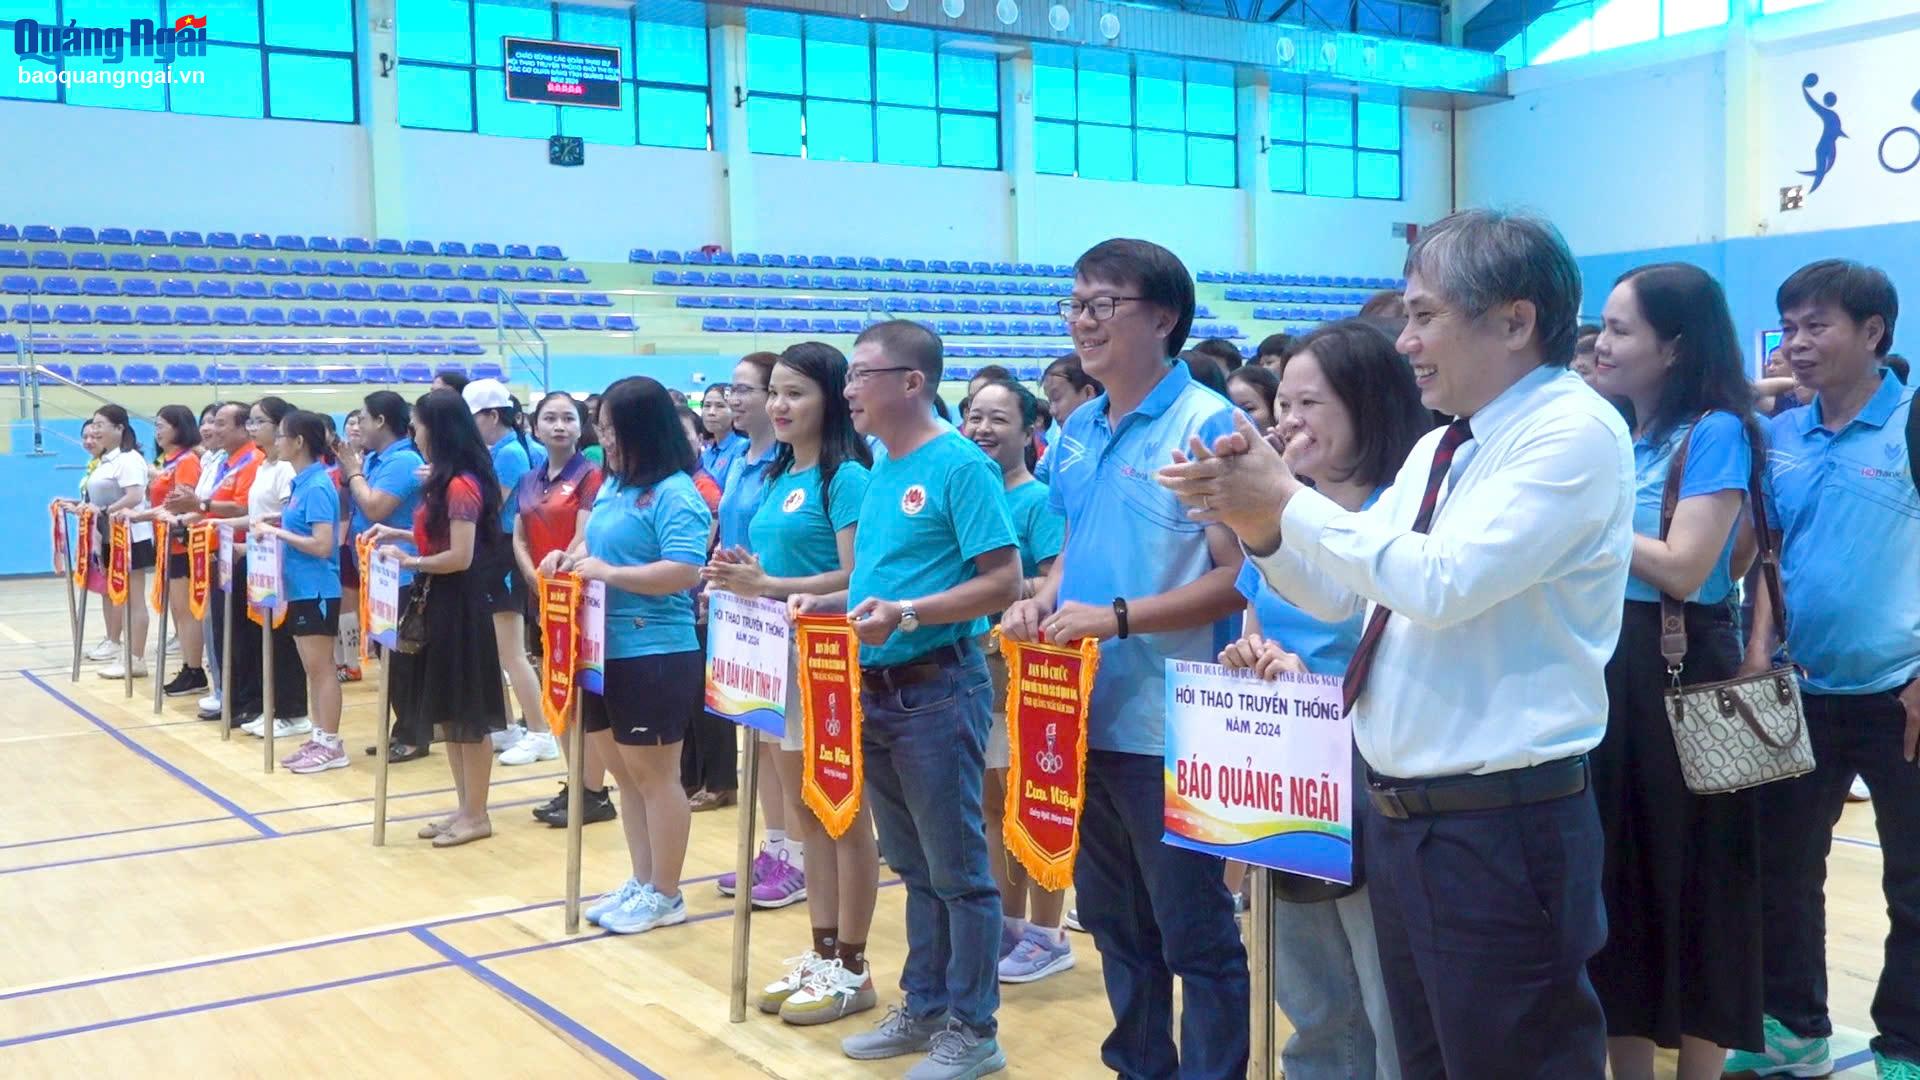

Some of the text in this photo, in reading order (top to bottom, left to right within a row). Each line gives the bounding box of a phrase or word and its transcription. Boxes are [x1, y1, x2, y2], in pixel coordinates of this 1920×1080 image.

[712, 656, 726, 685] BAN
[1200, 689, 1233, 709] THAO
[1238, 691, 1288, 716] TRUYỀN
[1294, 695, 1339, 721] THỐNG
[1226, 716, 1281, 738] NĂM 2024
[1177, 753, 1339, 823] BÁO QUẢNG NGÃI
